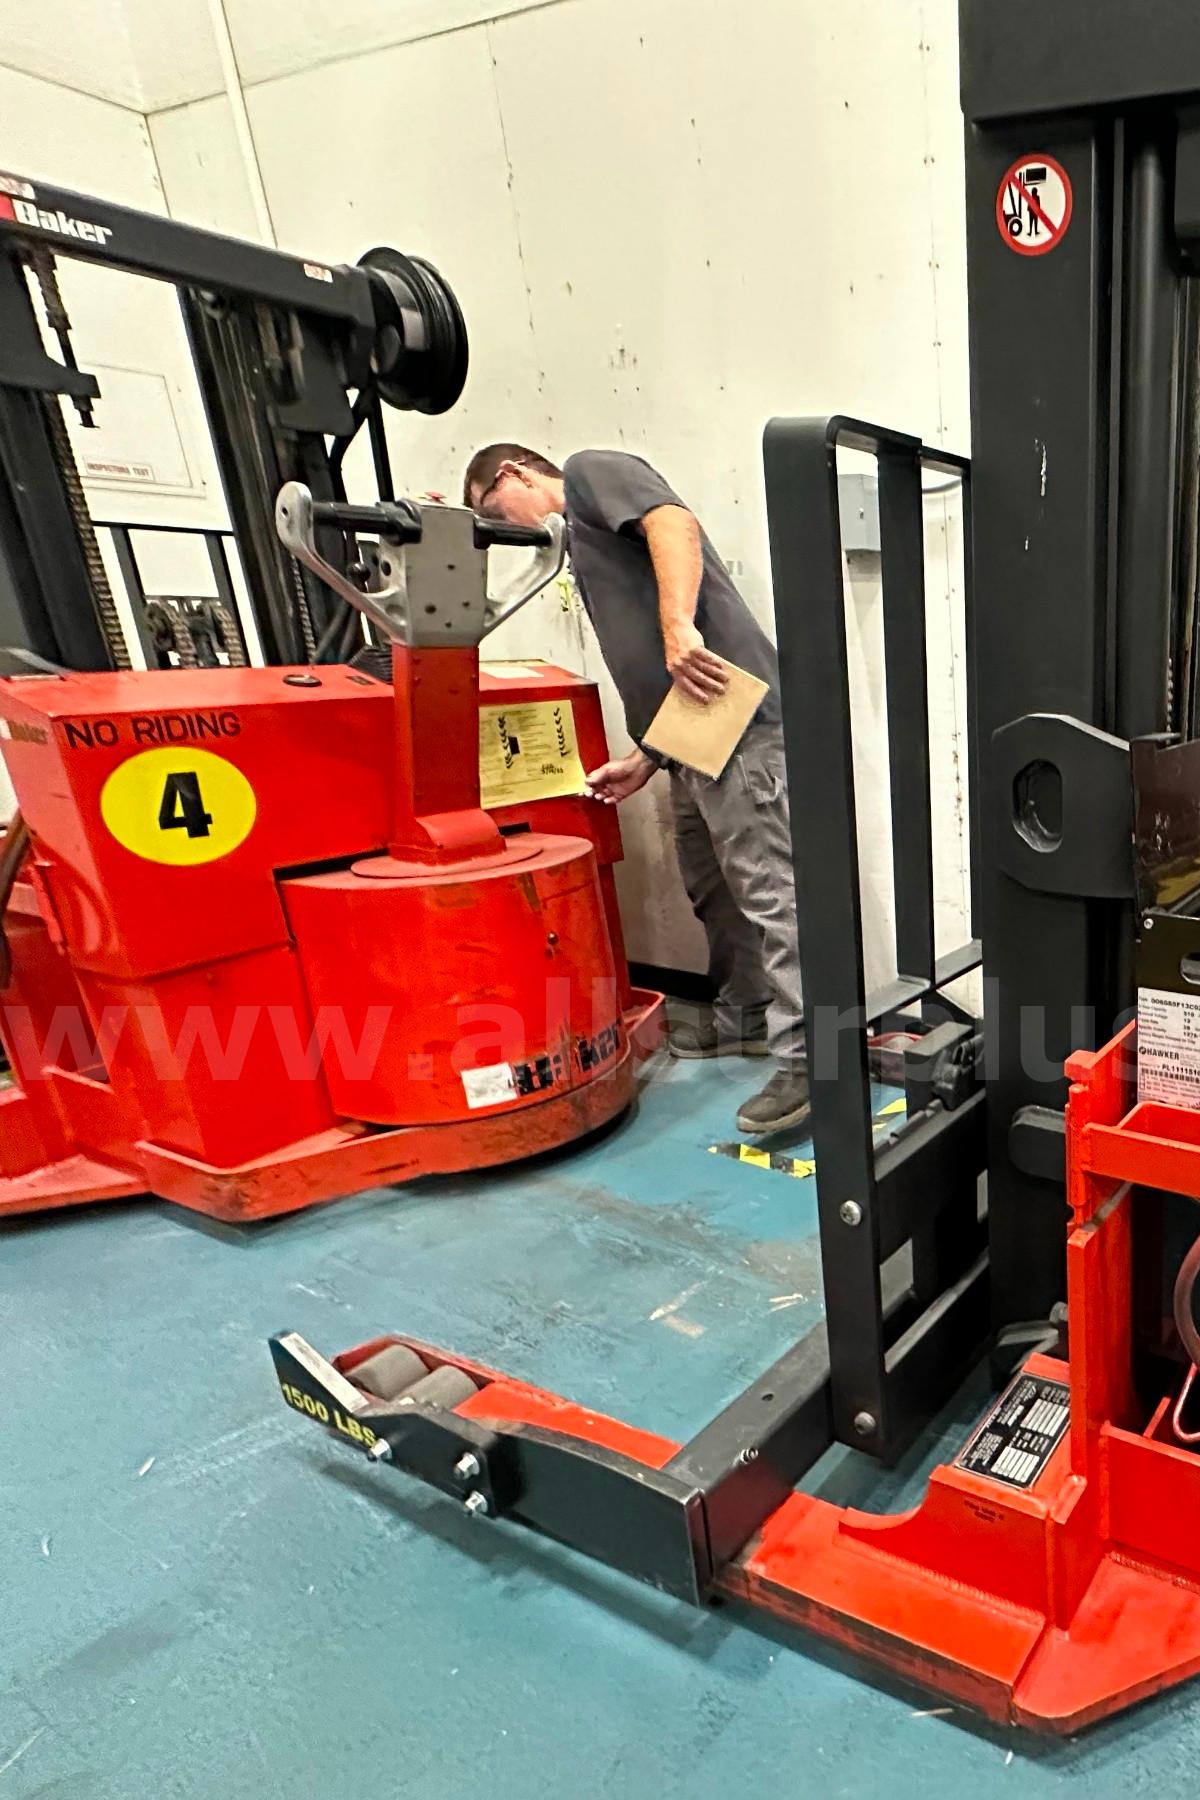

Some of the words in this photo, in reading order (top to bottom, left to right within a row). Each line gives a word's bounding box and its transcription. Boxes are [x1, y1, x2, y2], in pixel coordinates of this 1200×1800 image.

[11, 198, 113, 245] Baker
[64, 718, 119, 749] NO
[130, 711, 241, 745] RIDING
[158, 771, 213, 839] 4
[1146, 1047, 1180, 1061] HAWKER
[281, 1382, 329, 1423] 1500
[332, 1409, 377, 1448] LBS
